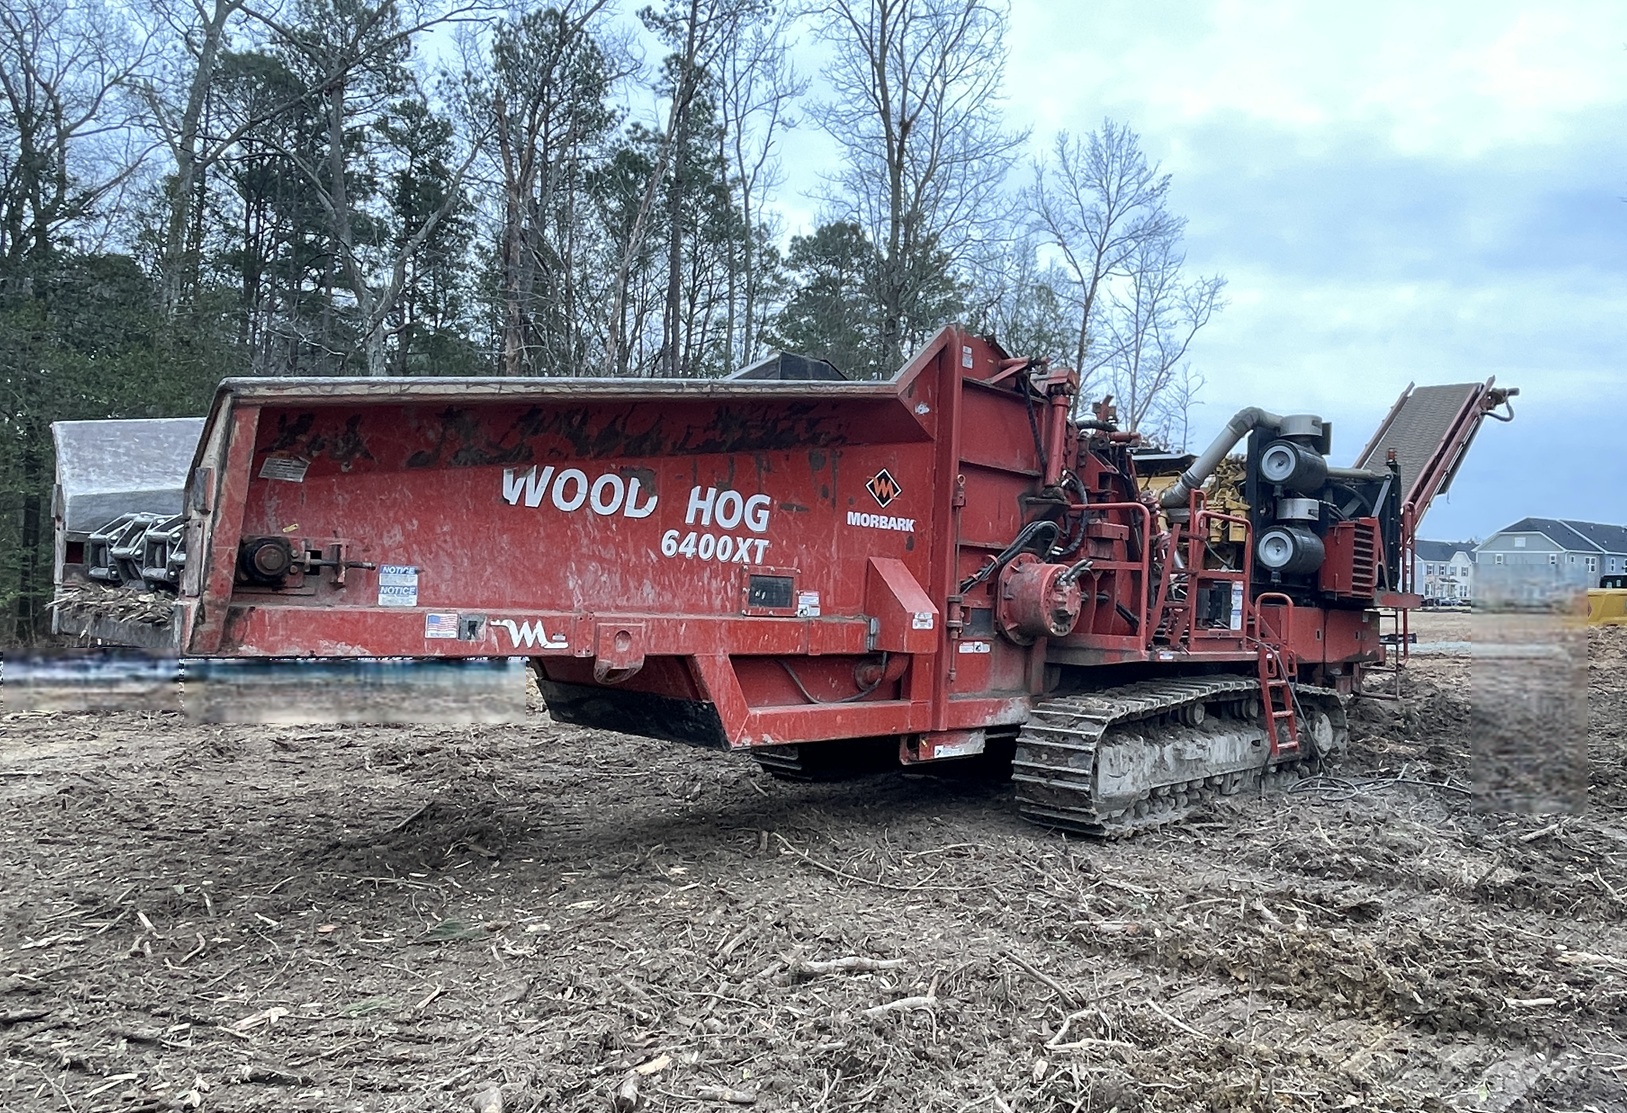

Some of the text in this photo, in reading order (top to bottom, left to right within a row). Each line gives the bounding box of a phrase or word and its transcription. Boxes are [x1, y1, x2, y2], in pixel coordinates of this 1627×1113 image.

[685, 485, 771, 533] HOG
[847, 511, 916, 533] MORBARK
[660, 529, 770, 565] 6400XT
[382, 566, 416, 574] NOTICE
[380, 586, 416, 595] NOTICE
